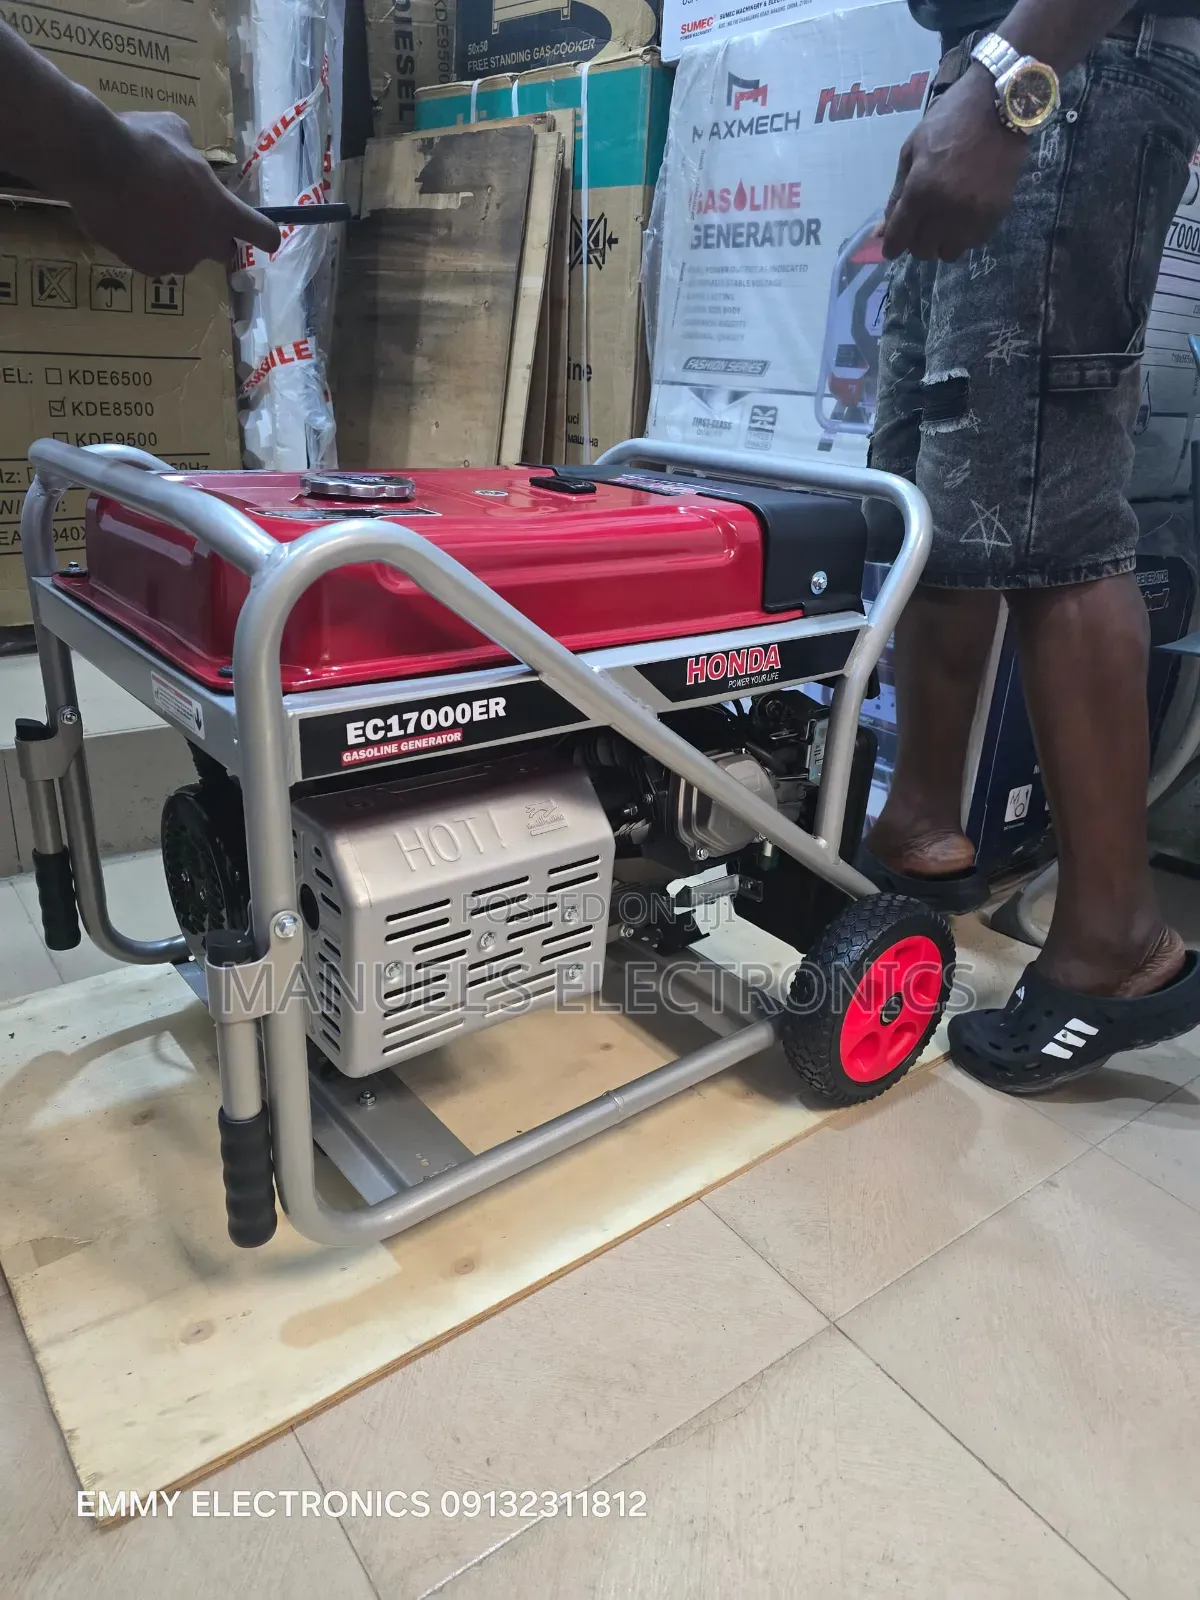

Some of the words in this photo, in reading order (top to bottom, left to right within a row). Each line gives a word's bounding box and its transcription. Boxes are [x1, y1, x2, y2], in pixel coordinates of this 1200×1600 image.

[0, 10, 171, 63] 40X540X695MM
[680, 16, 715, 35] SUMEC
[467, 57, 489, 72] FREE
[490, 49, 531, 68] STANDING
[533, 45, 552, 60] GAS
[552, 38, 596, 57] COOKER
[99, 78, 138, 97] MADE
[141, 87, 154, 100] IN
[157, 89, 197, 108] CHINA
[68, 369, 153, 387] KDE6500
[687, 357, 726, 372] FASHION
[727, 361, 765, 375] SERIES
[72, 401, 155, 417] KDE8500
[567, 434, 599, 448] машна
[686, 643, 782, 686] HONDA
[728, 677, 750, 689] POWER
[751, 674, 767, 685] YOUR
[767, 671, 780, 682] LIFE
[346, 696, 507, 745] EC17000ER
[342, 743, 398, 763] GASOLINE
[400, 731, 462, 751] GENERATOR
